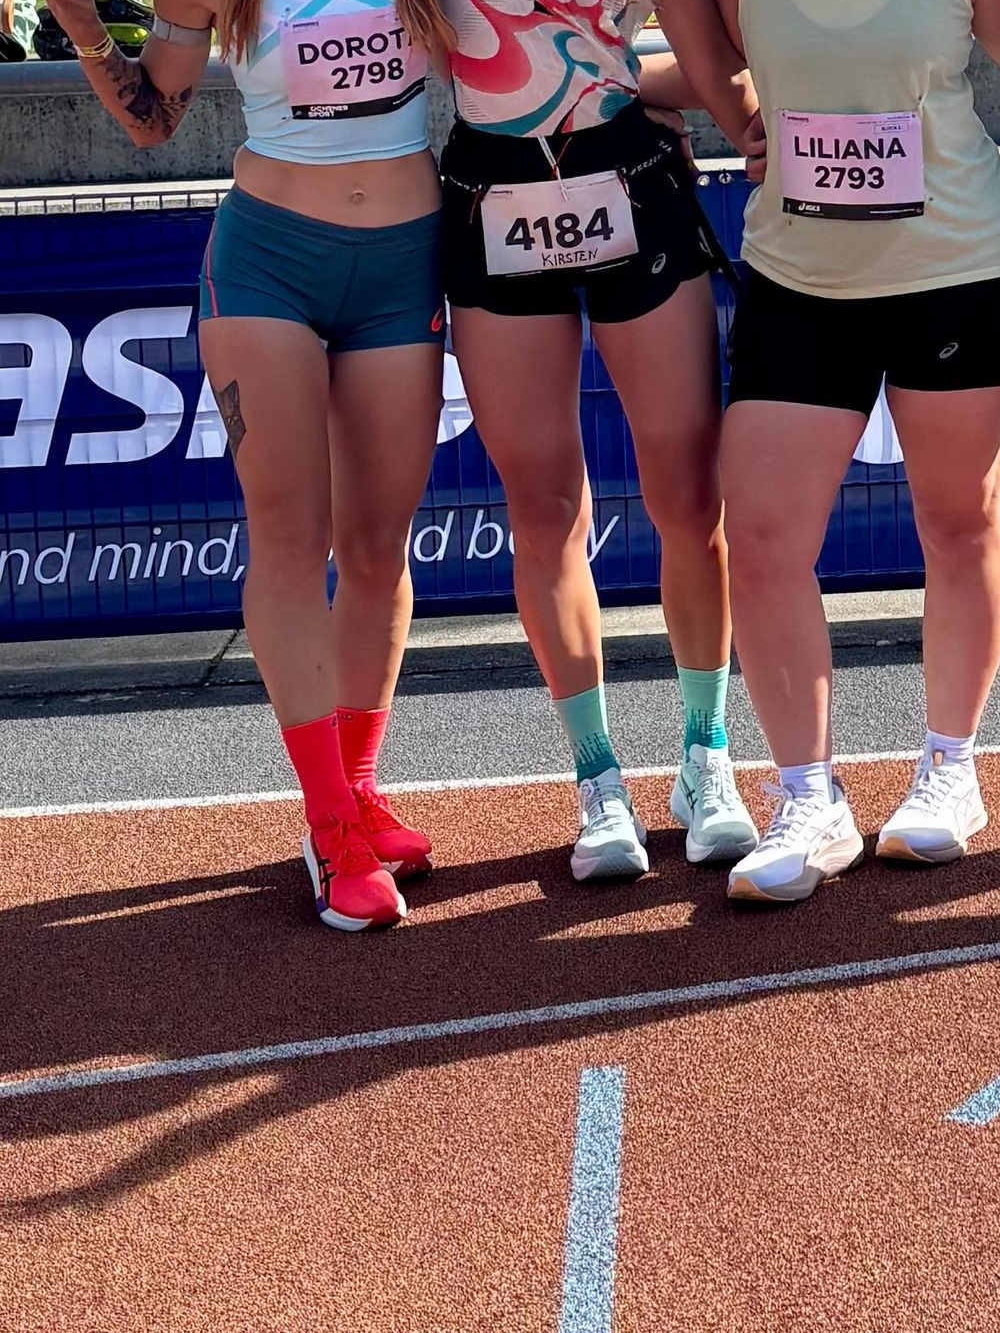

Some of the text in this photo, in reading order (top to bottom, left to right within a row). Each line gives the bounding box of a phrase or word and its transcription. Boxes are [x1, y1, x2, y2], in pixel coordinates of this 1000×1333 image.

[297, 27, 412, 65] DOROT
[331, 57, 404, 89] 2798
[794, 135, 907, 159] LILIANA
[814, 165, 885, 189] 2793
[505, 206, 614, 251] 4184
[541, 248, 599, 268] KIRSTEN
[88, 523, 246, 583] mind,
[466, 509, 620, 564] by
